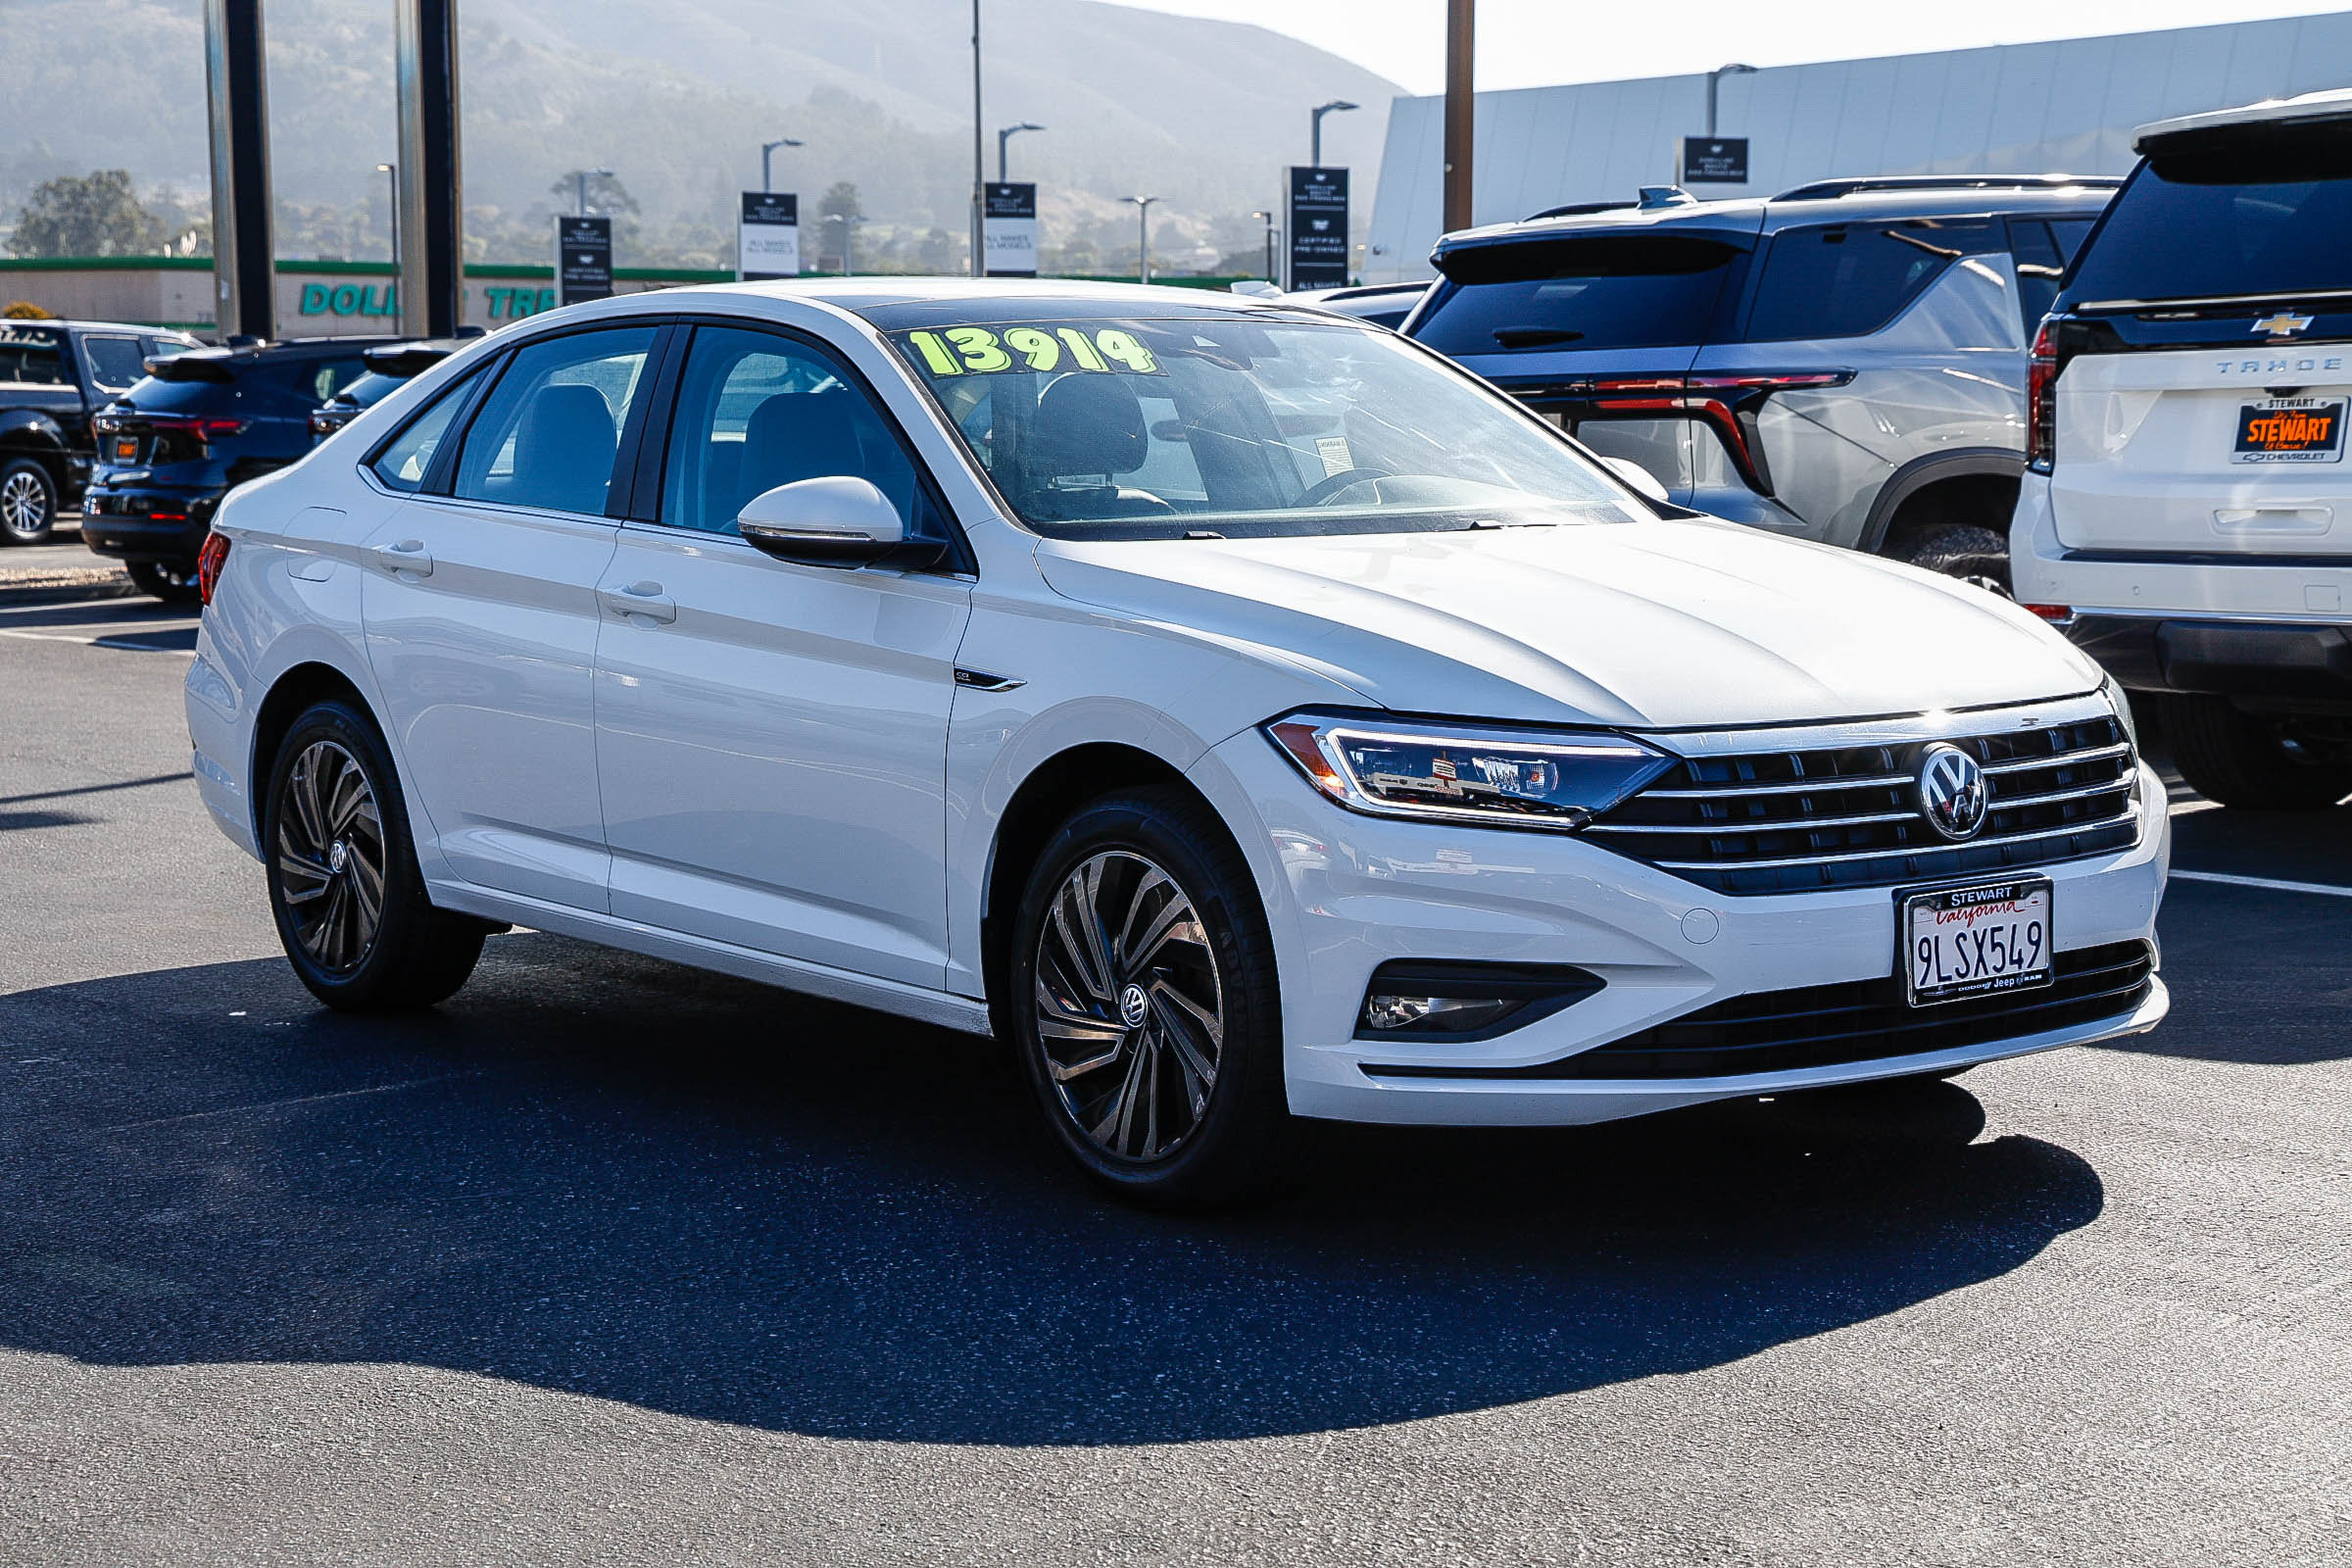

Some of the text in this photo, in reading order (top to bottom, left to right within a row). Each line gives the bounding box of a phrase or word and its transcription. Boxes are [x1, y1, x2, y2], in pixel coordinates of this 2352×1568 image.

[301, 283, 404, 316] DOLL
[909, 327, 1157, 374] 13914
[2217, 358, 2343, 373] TAHOE
[2269, 398, 2315, 409] STEWART
[2246, 416, 2332, 443] STEWART
[1951, 886, 2013, 906] STEWART
[1936, 900, 2026, 928] California
[1918, 920, 2042, 986] 9LSX549
[1993, 977, 2015, 988] Jeep
